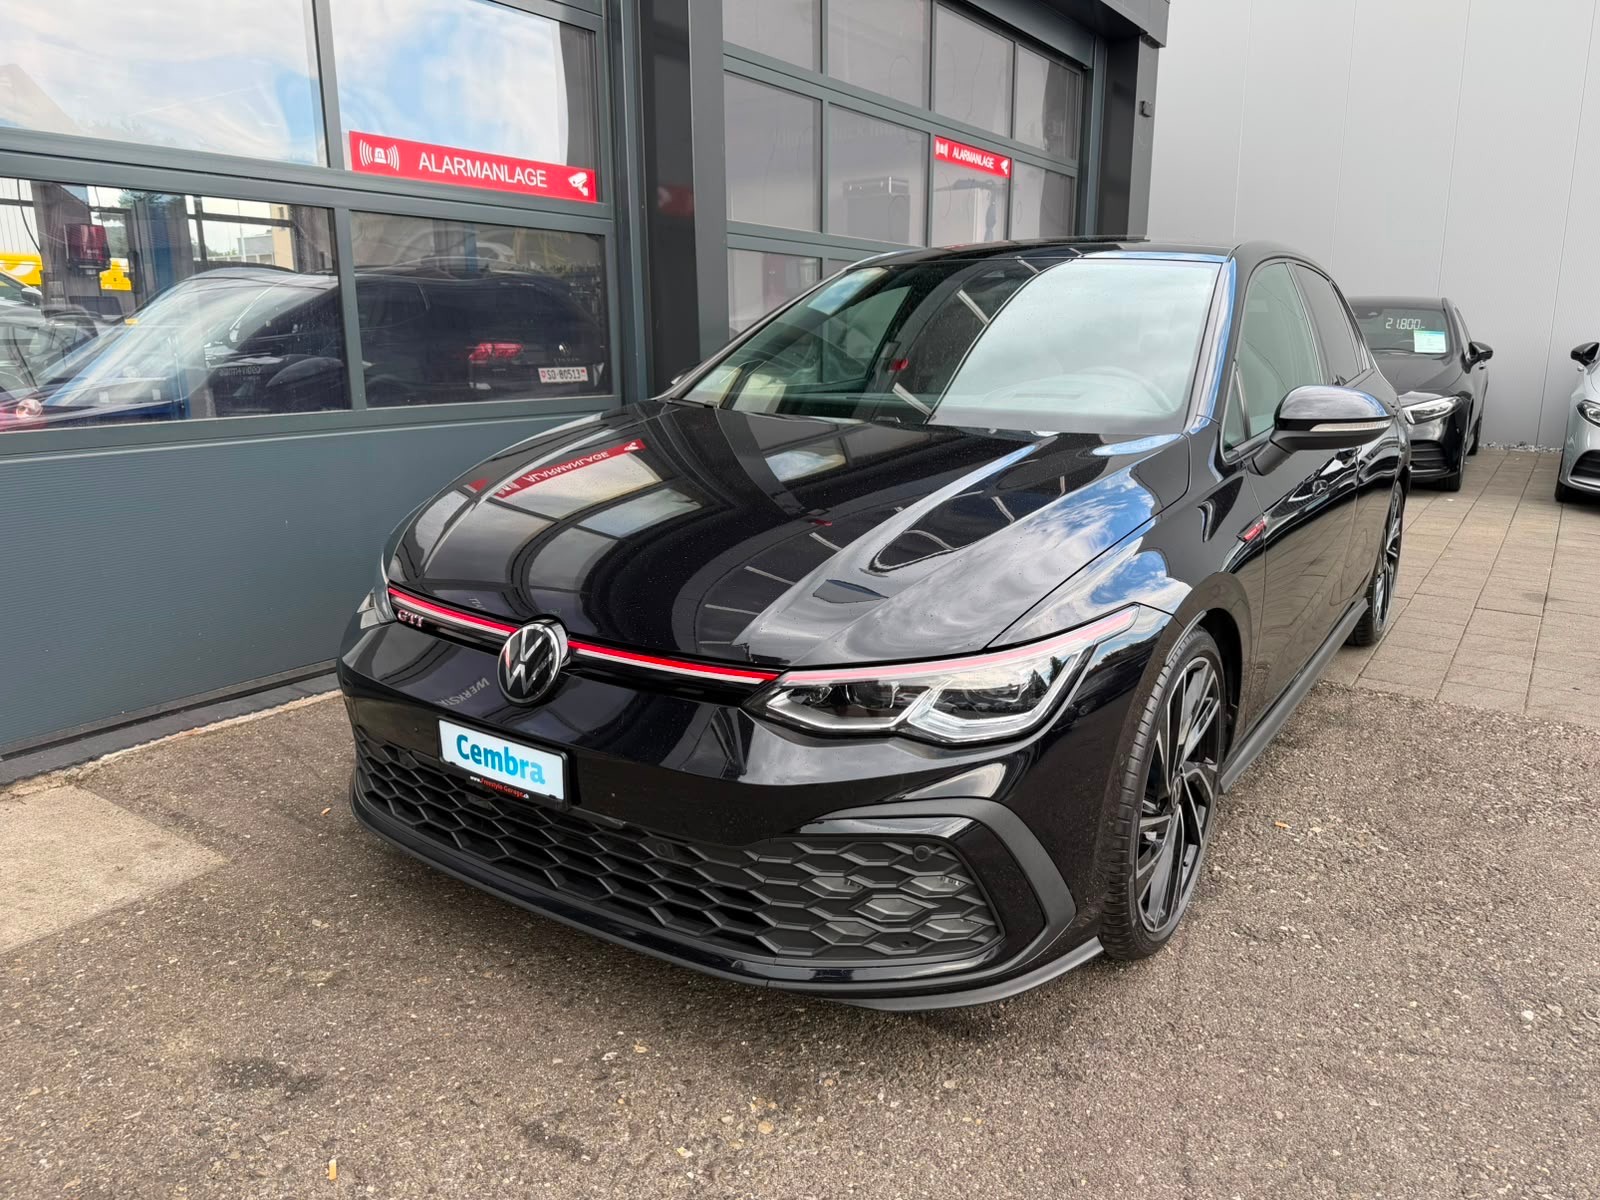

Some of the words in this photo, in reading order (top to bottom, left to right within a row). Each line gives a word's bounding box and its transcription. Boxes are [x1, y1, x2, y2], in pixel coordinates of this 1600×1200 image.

[418, 152, 548, 188] ALARMANLAGE
[952, 146, 995, 169] ALARMANLAGE
[397, 609, 424, 628] GTI
[501, 625, 559, 701] VW
[455, 734, 546, 785] Cembra
